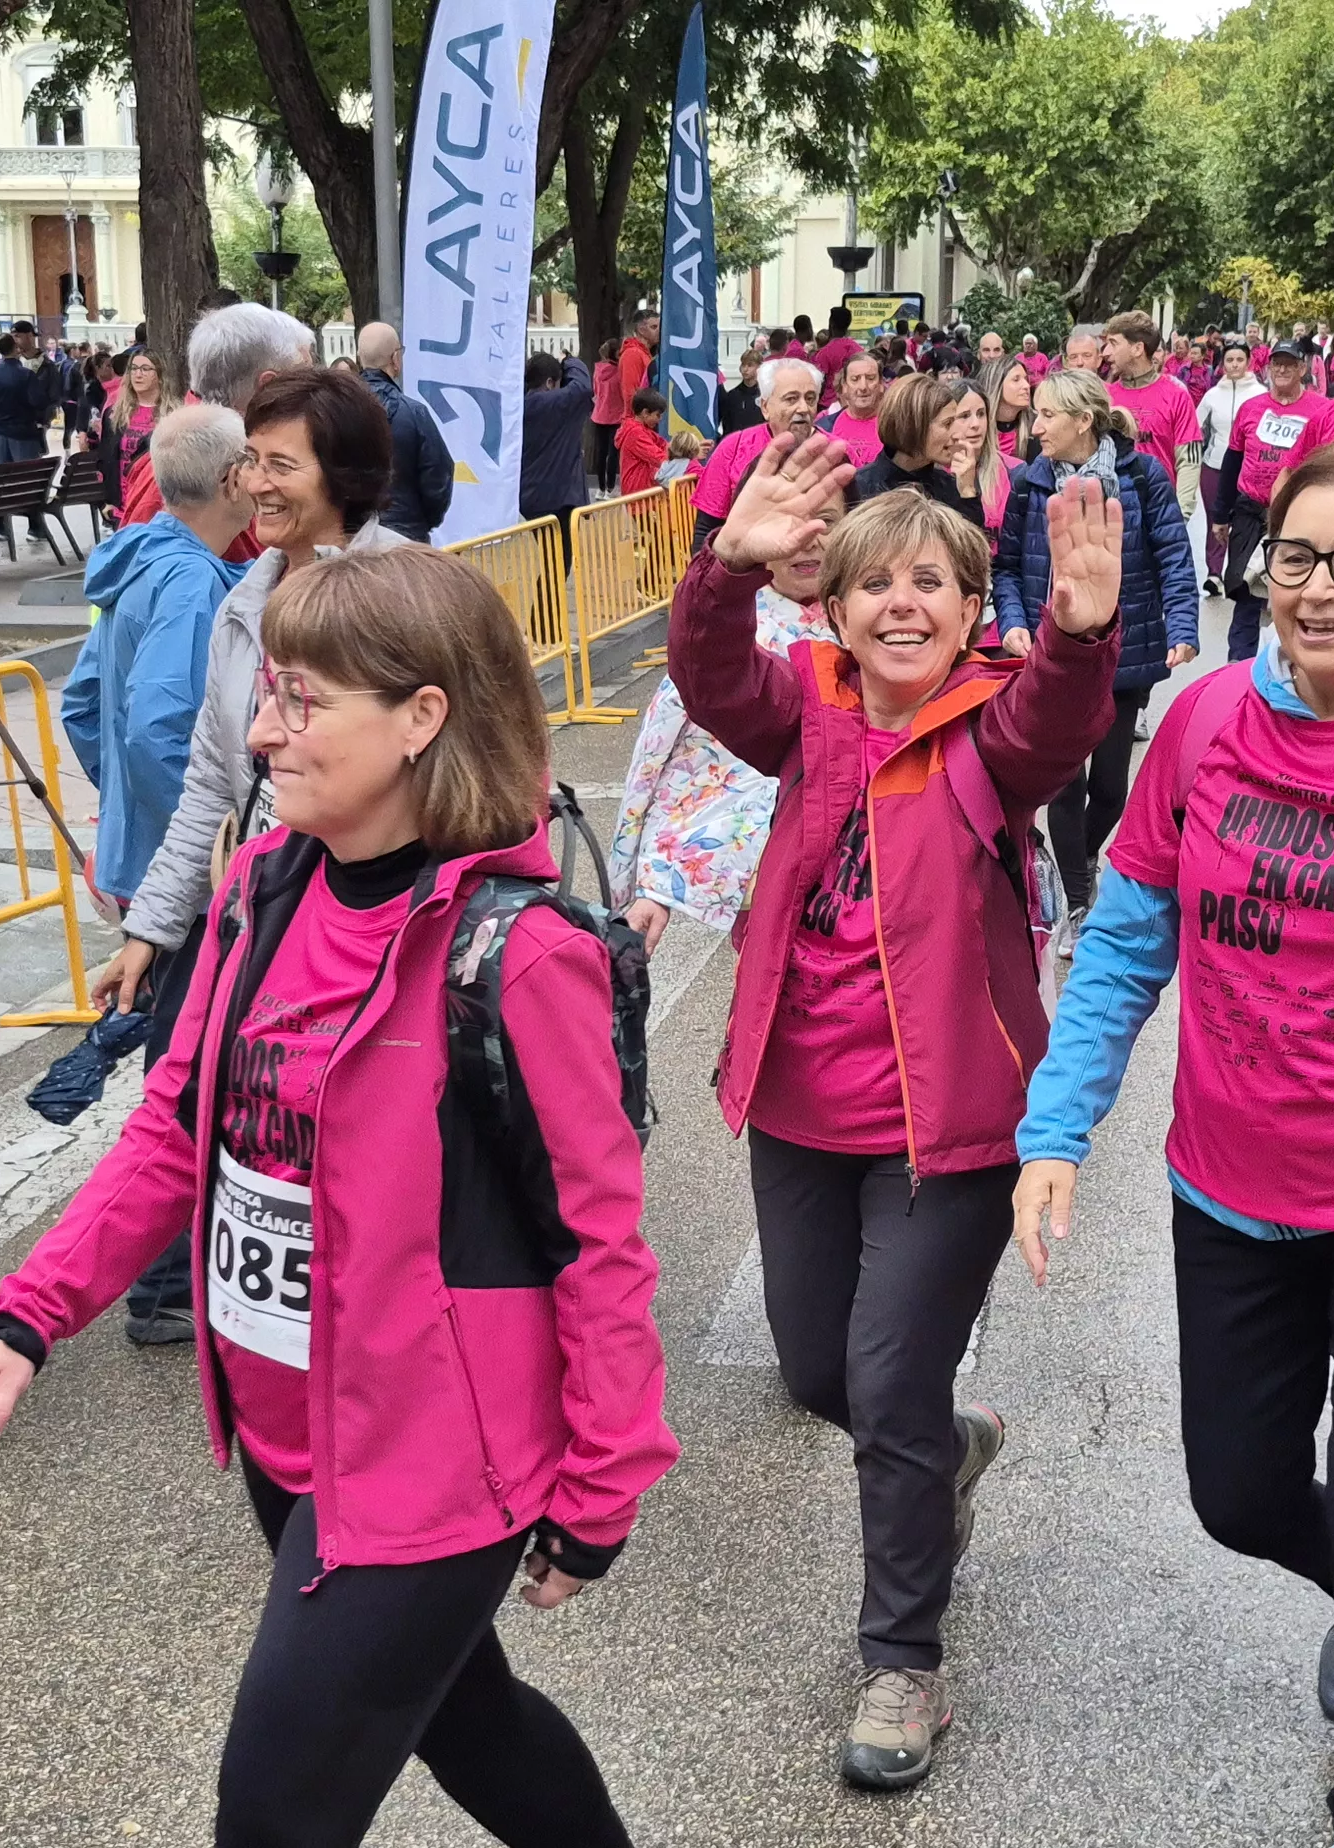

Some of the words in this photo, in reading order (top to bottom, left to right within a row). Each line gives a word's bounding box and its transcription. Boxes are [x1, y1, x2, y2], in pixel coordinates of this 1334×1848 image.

[419, 23, 505, 357] LAYCA
[489, 123, 525, 363] TALLERES
[669, 100, 705, 350] LAYCA
[1277, 784, 1327, 804] CONTRA
[1247, 850, 1296, 902] EN
[1198, 888, 1286, 956] PASO
[288, 1020, 306, 1035] EL
[233, 1201, 249, 1221] EL
[216, 1217, 312, 1312] 085
